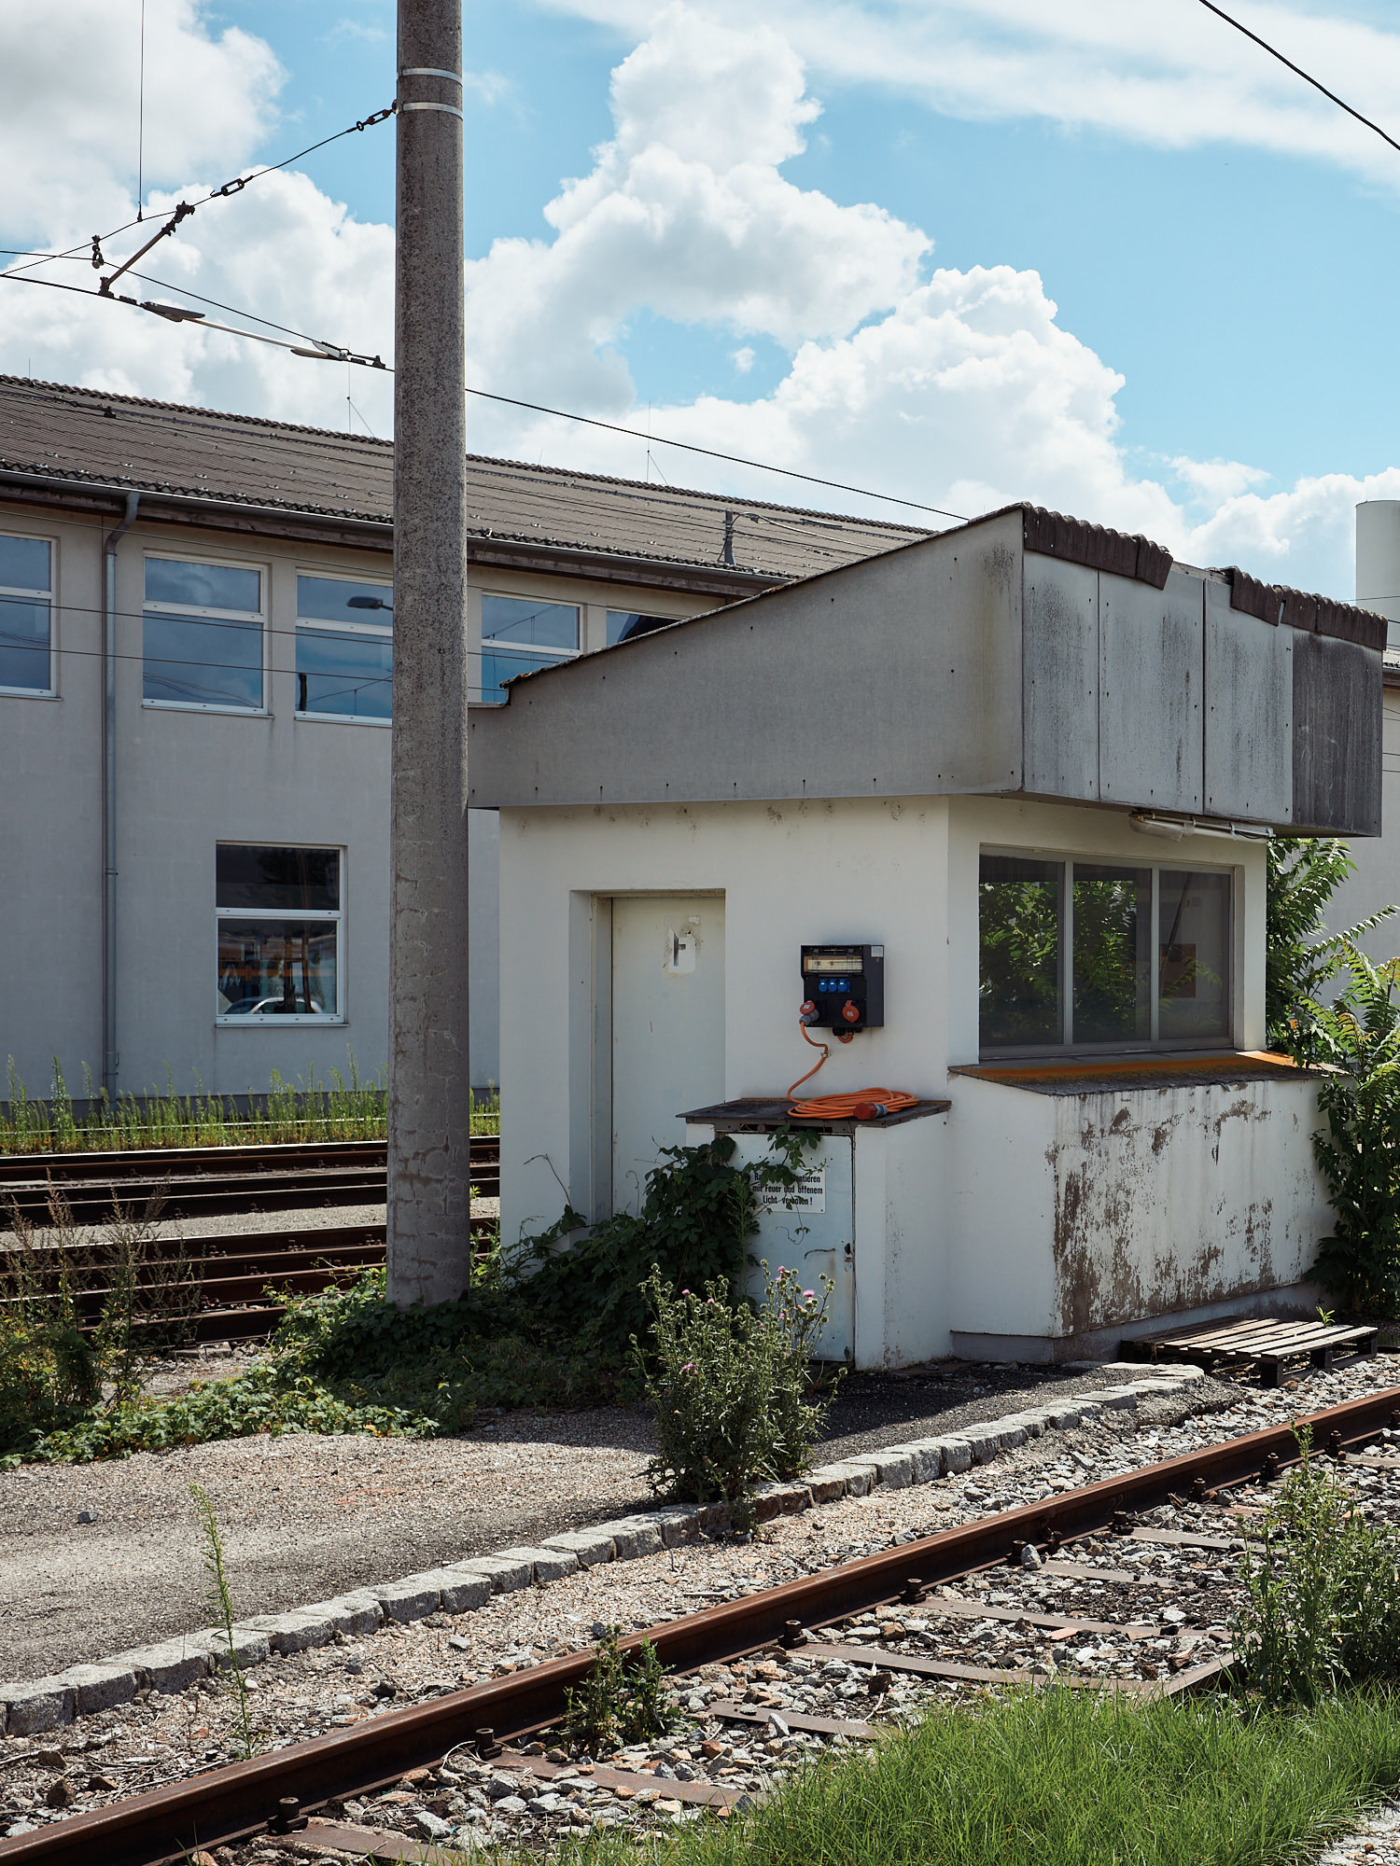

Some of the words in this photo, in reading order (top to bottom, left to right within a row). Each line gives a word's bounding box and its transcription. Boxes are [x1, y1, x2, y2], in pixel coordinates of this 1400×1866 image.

[765, 1185, 782, 1193] Feuer
[784, 1185, 795, 1193] und
[797, 1186, 823, 1194] offenem
[762, 1195, 778, 1204] Licht
